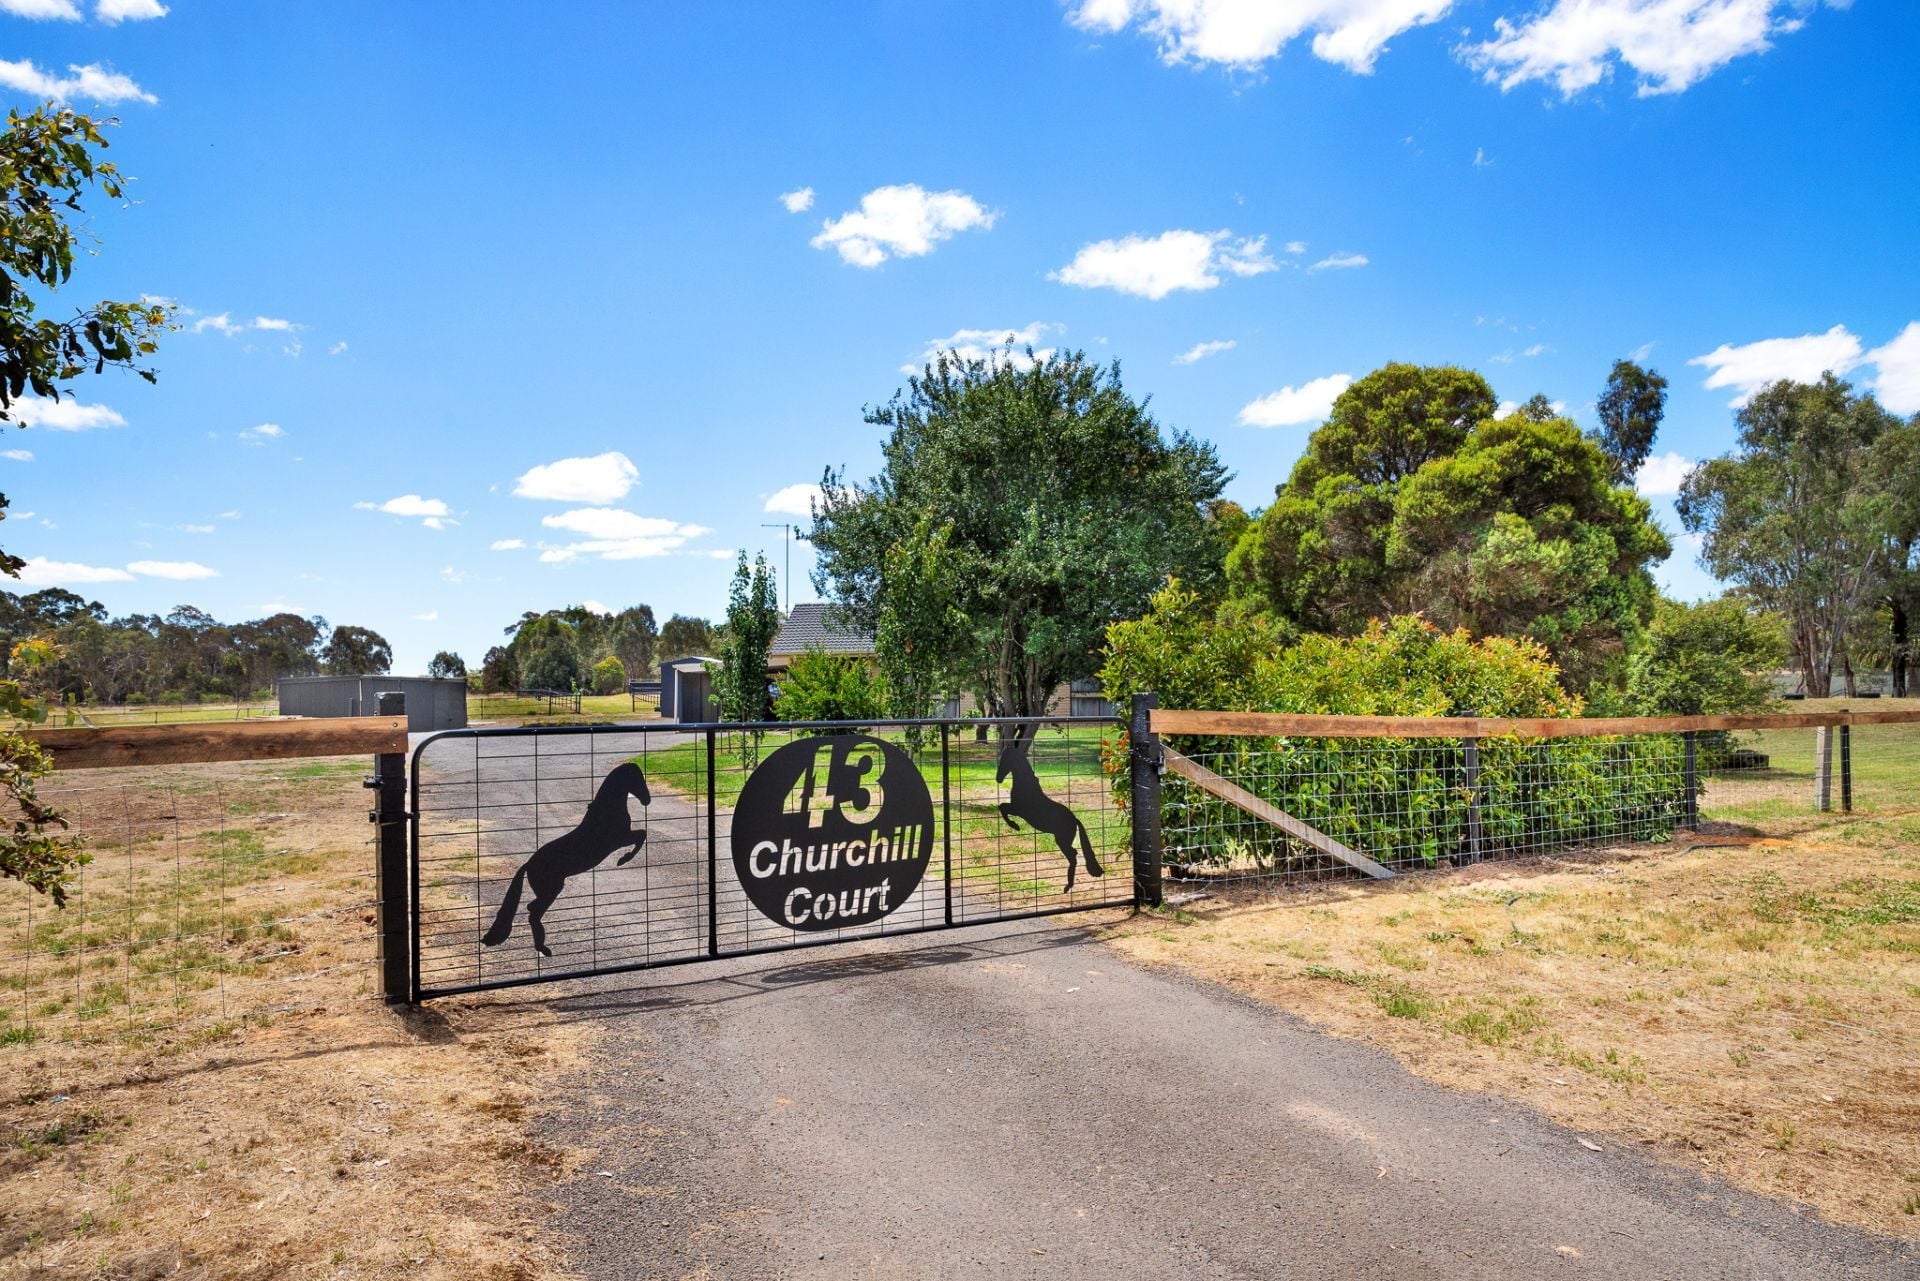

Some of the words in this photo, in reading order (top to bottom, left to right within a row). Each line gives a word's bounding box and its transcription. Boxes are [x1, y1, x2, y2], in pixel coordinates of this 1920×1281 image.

[782, 742, 886, 828] 43
[749, 824, 922, 879] Churchill
[784, 877, 891, 925] Court
